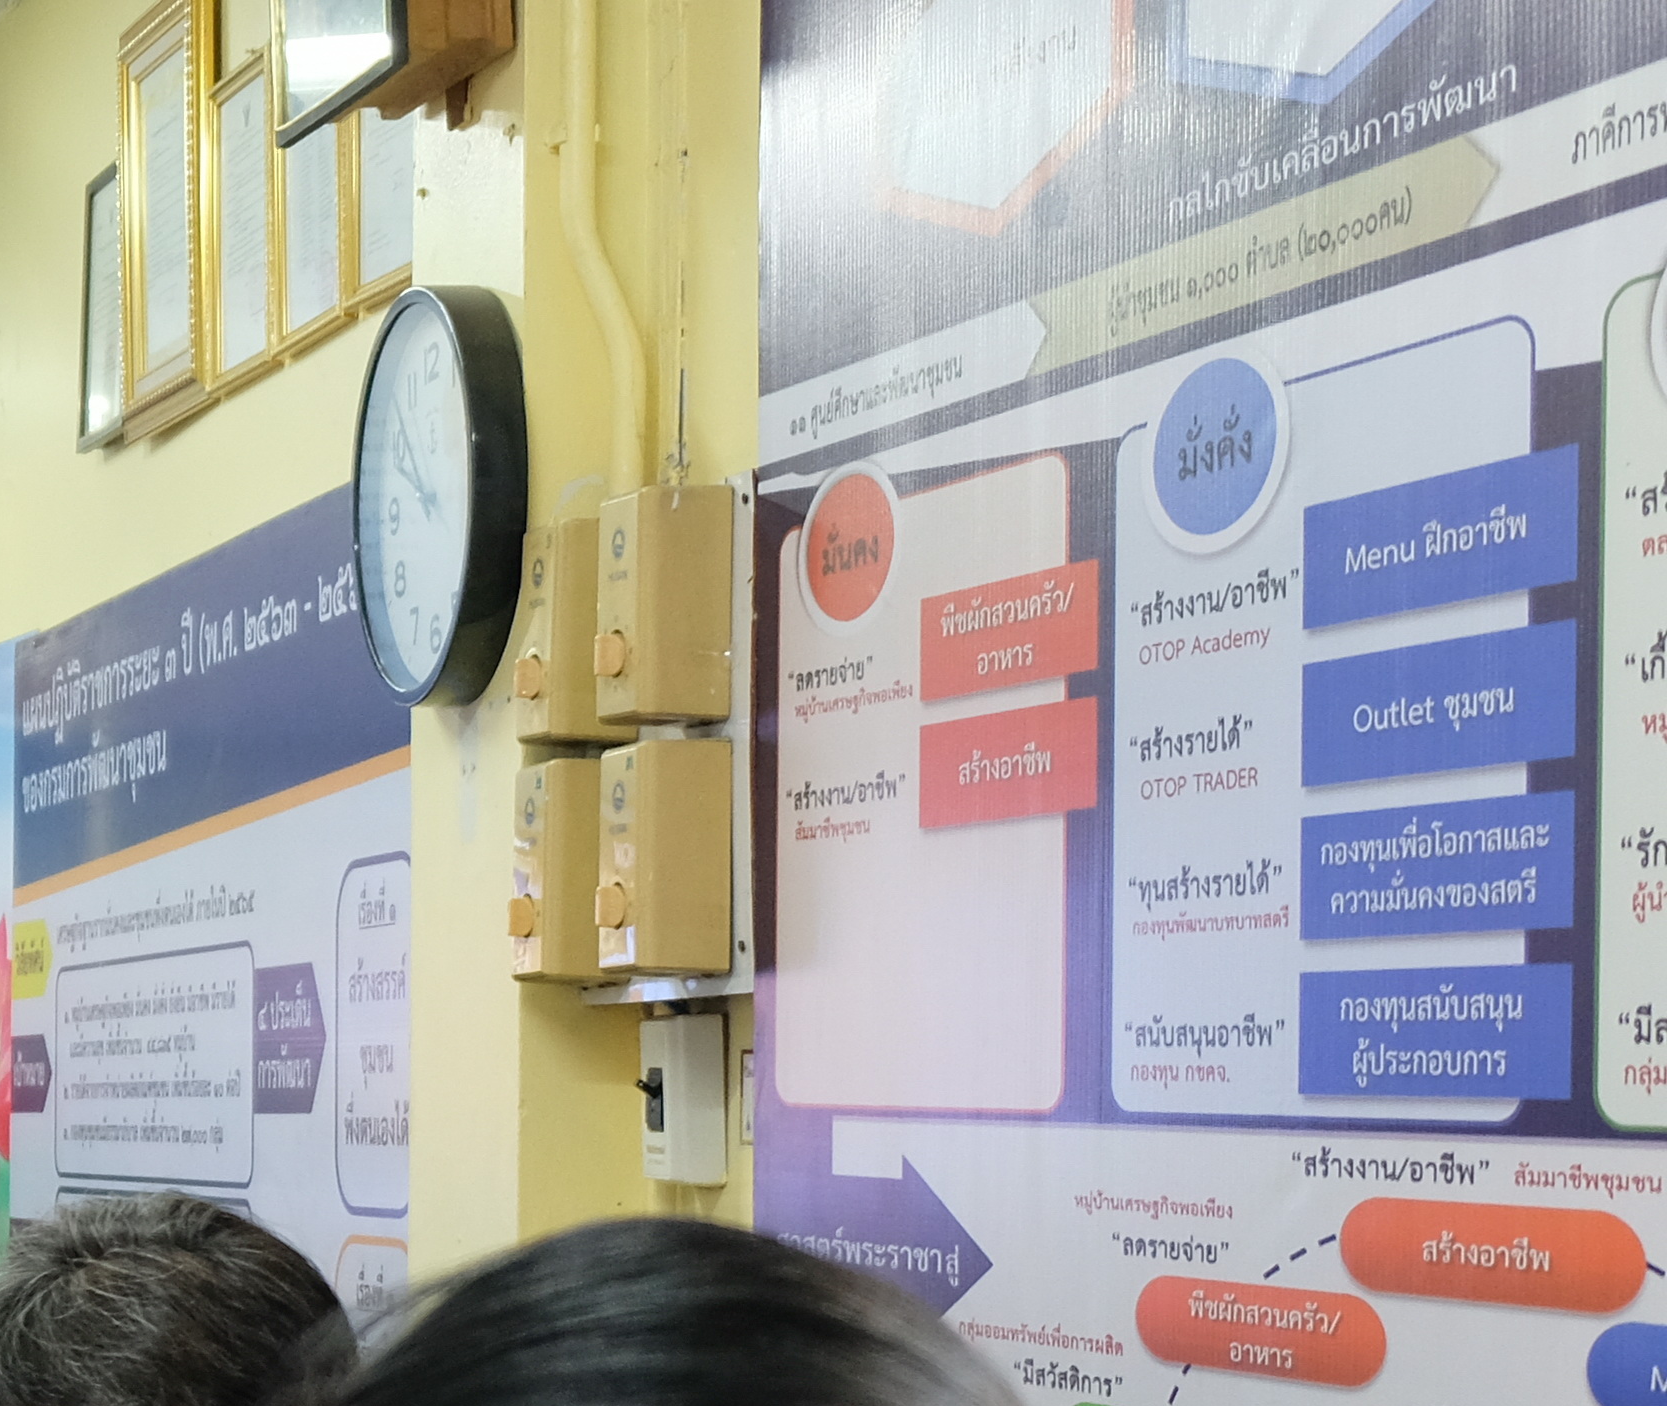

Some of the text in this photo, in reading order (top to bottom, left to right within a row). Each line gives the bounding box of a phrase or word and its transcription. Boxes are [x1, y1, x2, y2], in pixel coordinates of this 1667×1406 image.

[1167, 63, 1518, 222] กลไกขับเคลื่อนการพัฒนา
[1245, 234, 1292, 278] ตำบล
[423, 341, 440, 386] 12
[1177, 403, 1254, 483] มั่งคั่ง
[387, 496, 401, 536] 9
[821, 521, 880, 577] มั่นคง
[1345, 504, 1528, 575] Menu ฝึกอาชีพ
[393, 559, 407, 599] 8
[1130, 567, 1300, 628] “สร้างงาน/อาชีพ”
[409, 605, 420, 647] 7
[940, 579, 1074, 638] พืชผักสวนครัว/
[180, 606, 195, 676] ปี
[428, 613, 443, 655] 6
[1139, 627, 1271, 667] OTOP Academy
[977, 643, 1034, 676] อาหาร
[1353, 686, 1515, 734] Outlet ชุมชน
[1129, 713, 1254, 763] “สร้างรายได้”
[22, 729, 168, 814] ของกรมการพัฒนาชุมชน
[958, 741, 1051, 786] สร้างอาชีพ
[1140, 766, 1259, 802] OTOP TRADER
[1320, 817, 1551, 872] กองทุนเพื่อโอกาสและ
[1128, 858, 1283, 912] “ทุนสร้างรายได้”
[1330, 866, 1538, 916] ความมั่นคงของสตรี
[348, 952, 407, 1005] สร้างสรรค์
[270, 979, 312, 1031] ประเด็น
[1338, 983, 1523, 1033] กองทุนสนับสนุน
[1124, 1013, 1286, 1059] “สนับสนุนอาชีพ”
[256, 1044, 313, 1090] การพัฒนา
[359, 1044, 395, 1089] ชุมชน
[1129, 1061, 1179, 1090] กองทุน
[1352, 1039, 1507, 1087] ผู้ประกอบการ
[1291, 1145, 1663, 1201] “สร้างงาน/อาชีพ” สัมมาชีพชุมชน
[1111, 1231, 1231, 1265] “ลดรายจ่าย”
[1420, 1232, 1551, 1274] สร้างอาชีพ
[1186, 1290, 1341, 1336] พืชผักสวนครัว/
[1013, 1358, 1124, 1398] “มีสวัสดิการ”
[1228, 1338, 1294, 1372] อาหาร
